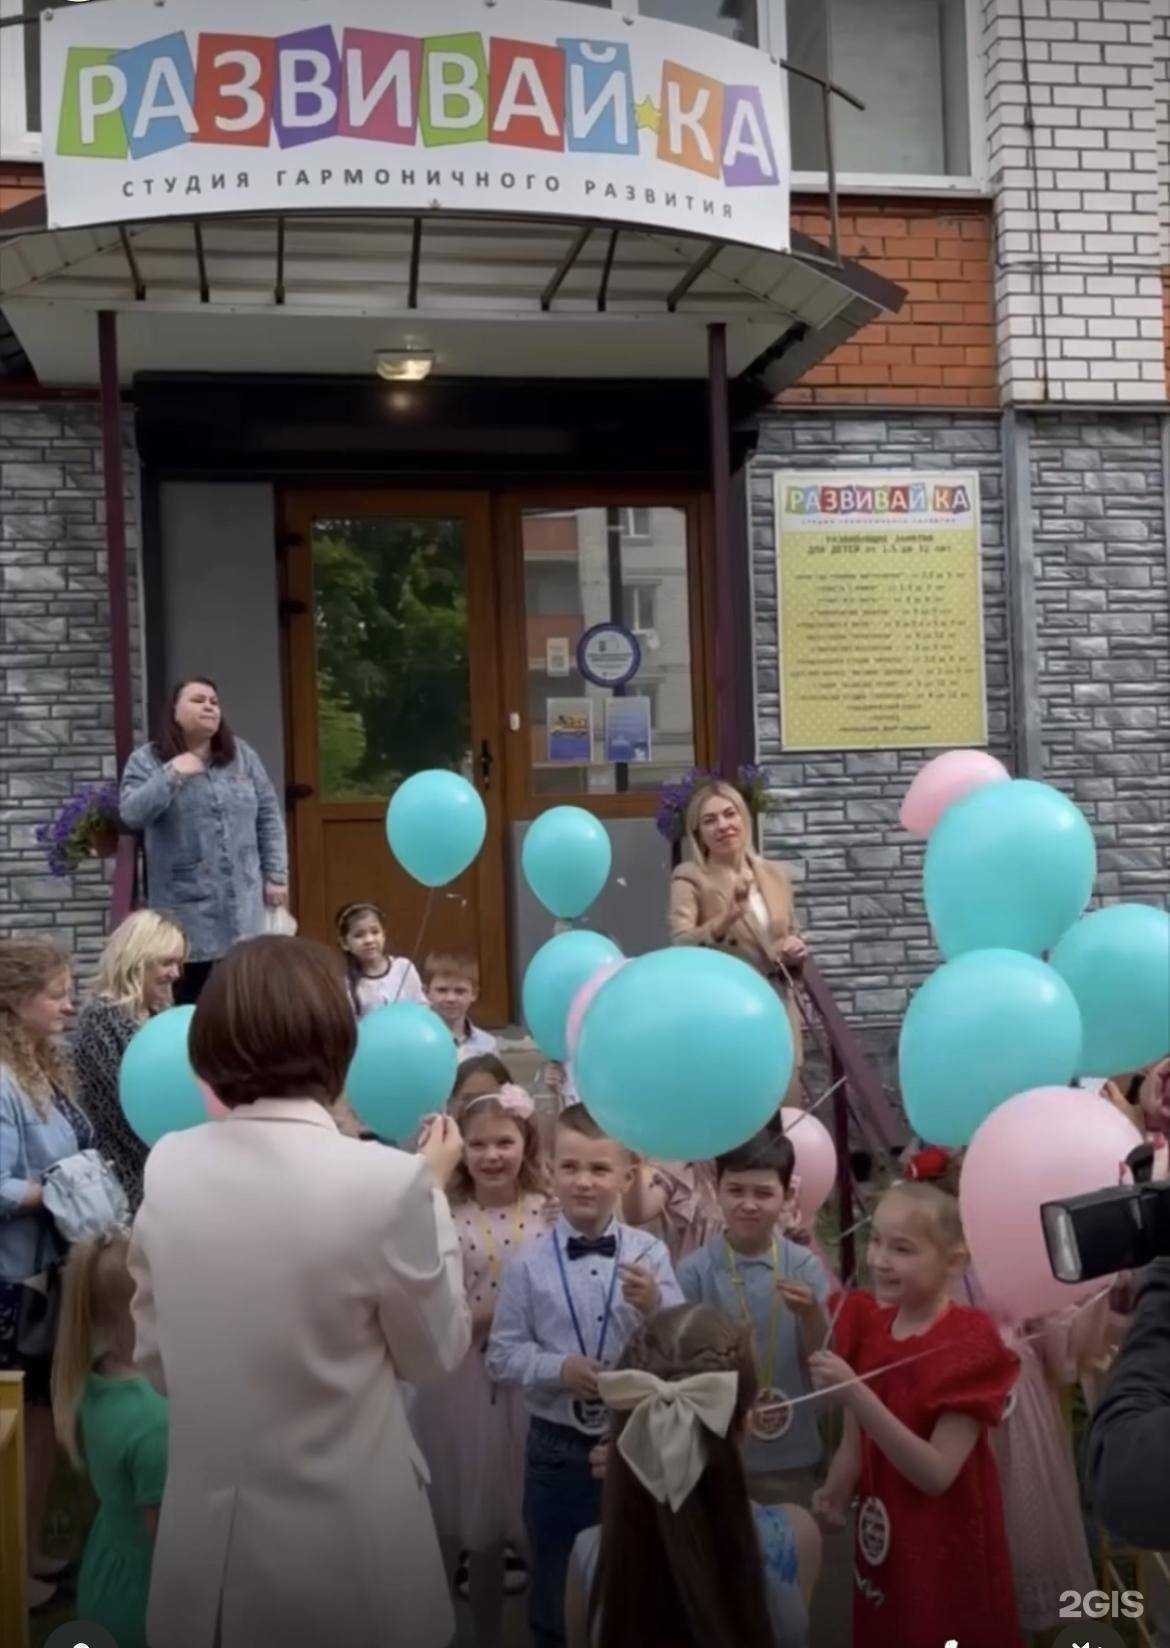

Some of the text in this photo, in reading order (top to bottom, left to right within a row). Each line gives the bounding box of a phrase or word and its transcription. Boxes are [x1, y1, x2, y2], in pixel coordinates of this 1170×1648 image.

[122, 168, 734, 220] СТУДИЯ ГАРМОНИЧНОГО РАЗВИТИЯ
